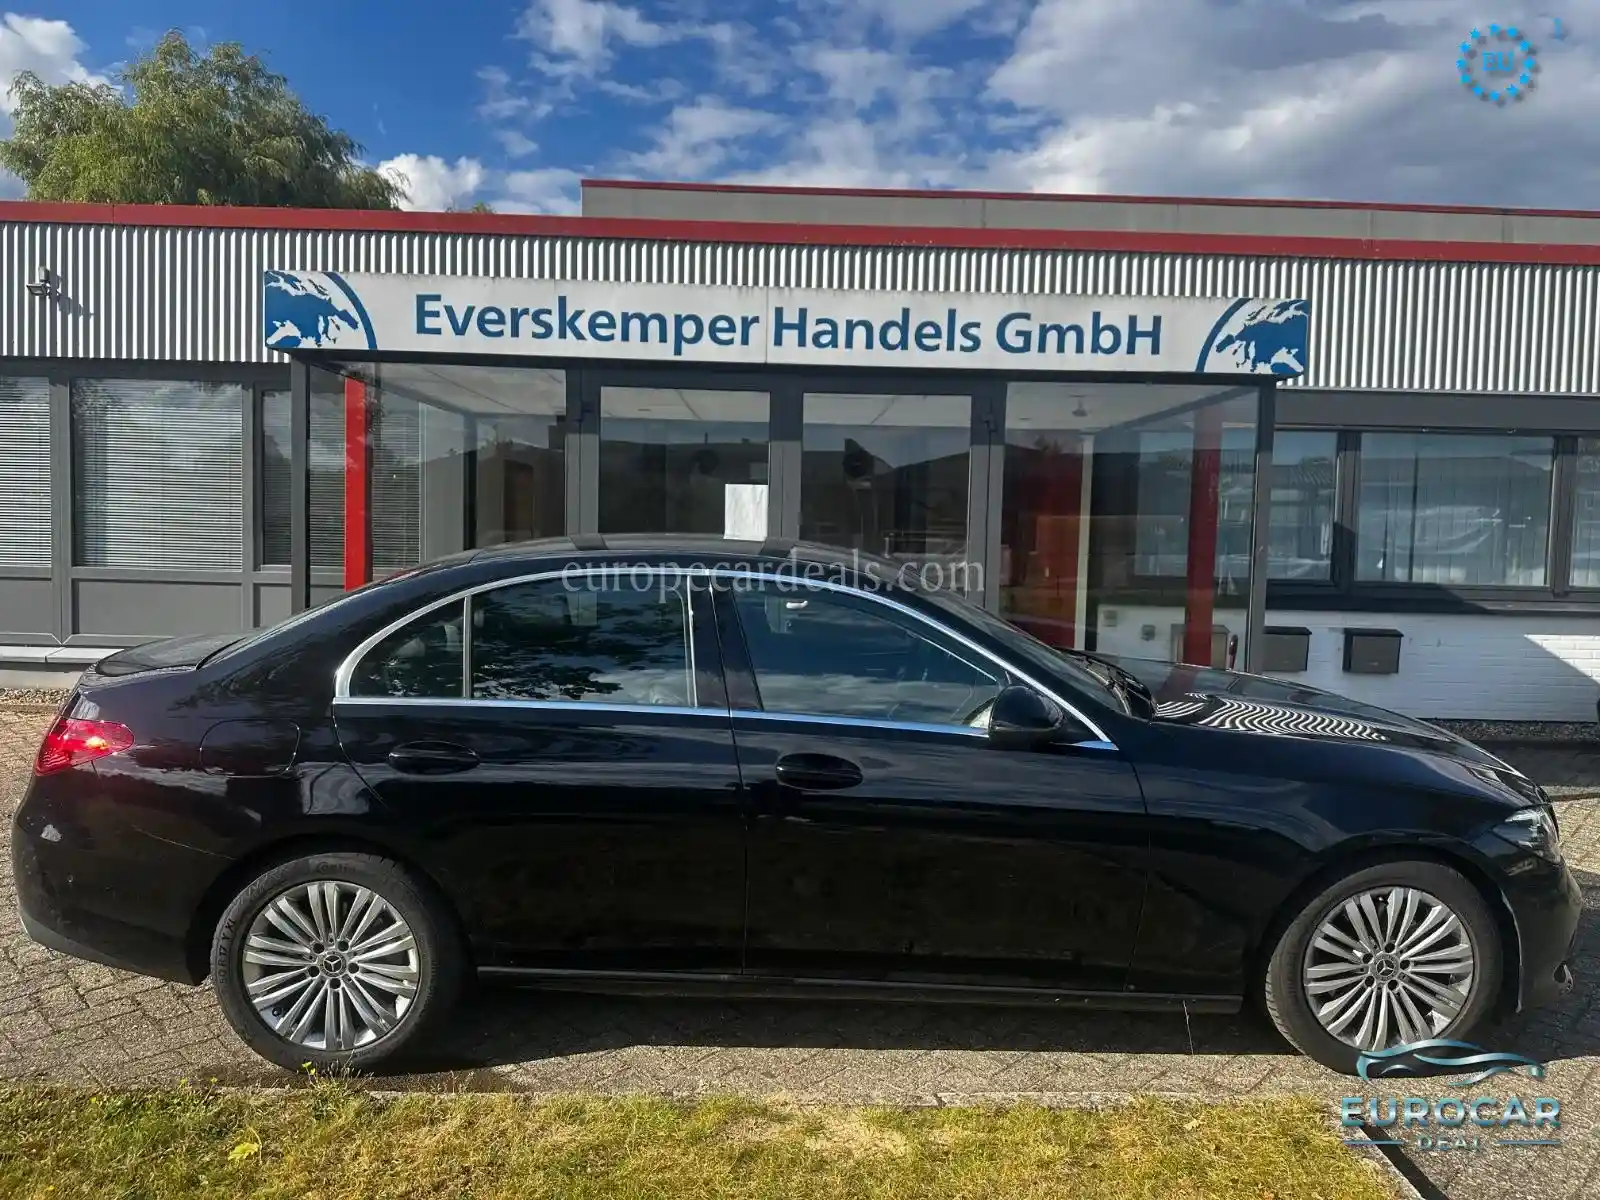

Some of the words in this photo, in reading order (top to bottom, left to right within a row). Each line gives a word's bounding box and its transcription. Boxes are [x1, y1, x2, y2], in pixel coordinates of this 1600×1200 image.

[415, 293, 760, 356] Everskemper
[773, 306, 981, 353] Handels
[996, 311, 1162, 355] GmbH
